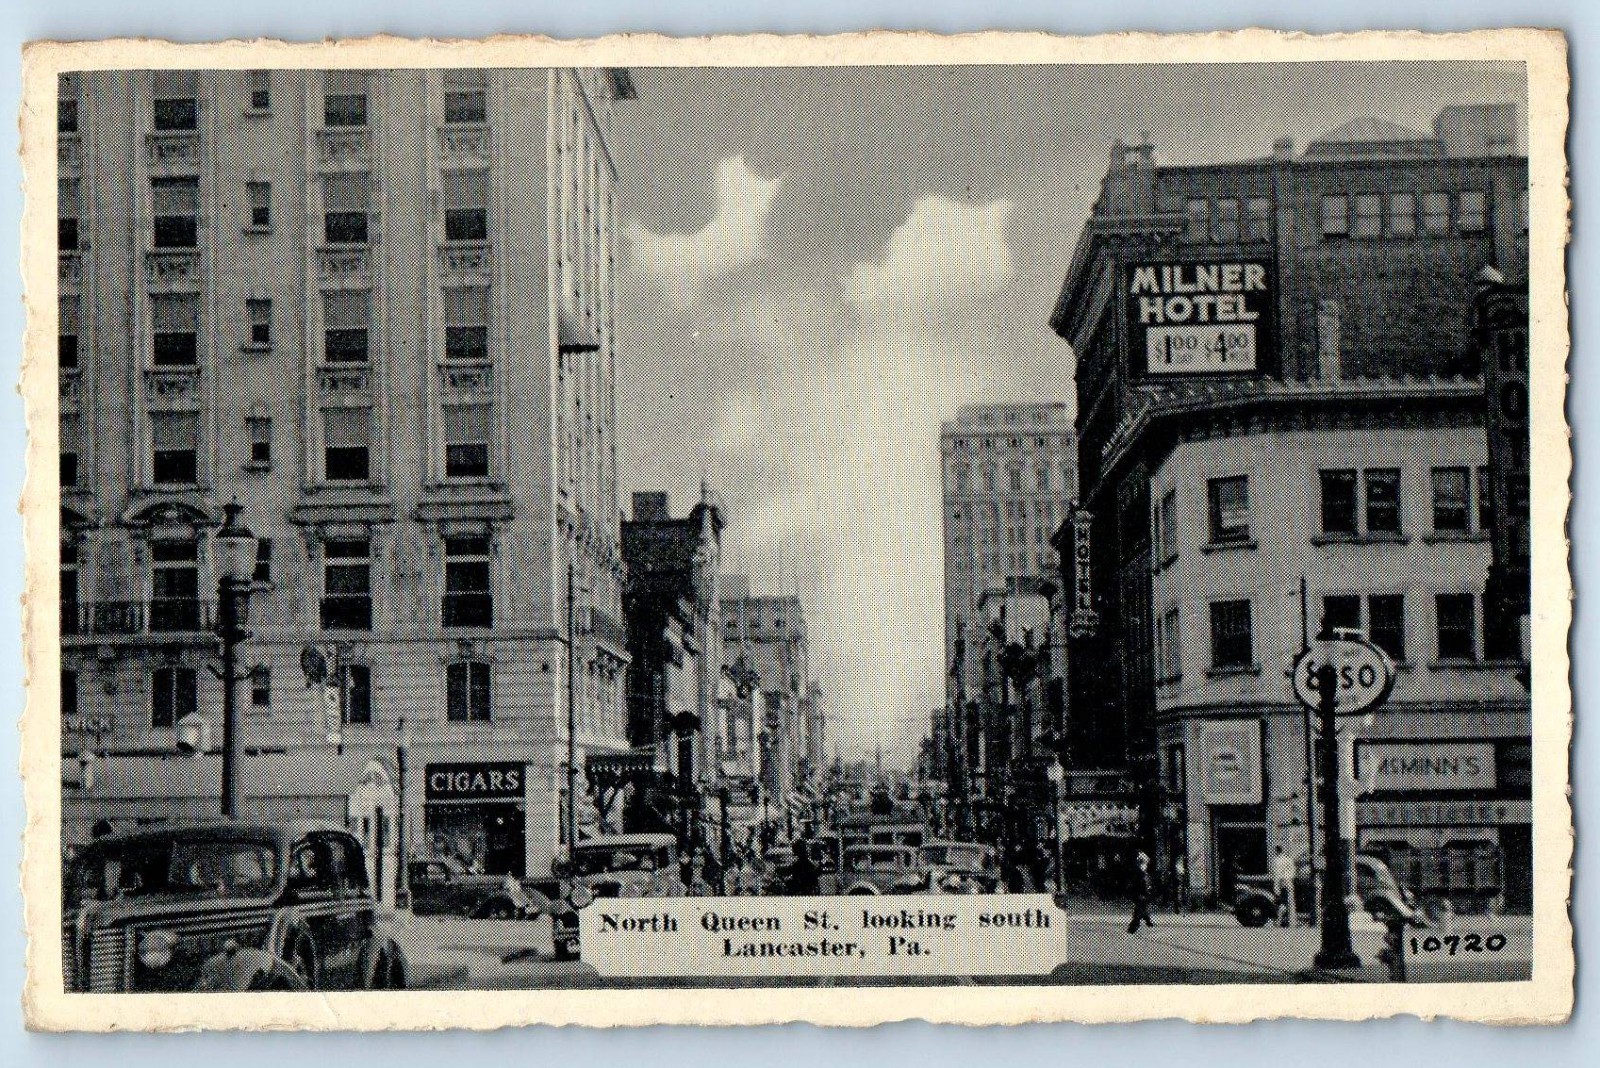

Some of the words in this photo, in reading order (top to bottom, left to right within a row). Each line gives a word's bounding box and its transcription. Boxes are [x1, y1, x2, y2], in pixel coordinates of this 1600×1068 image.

[1130, 263, 1267, 294] MILNER
[1140, 294, 1260, 323] HOTEL
[1076, 527, 1090, 609] HOTEL
[430, 769, 520, 792] CIGARS
